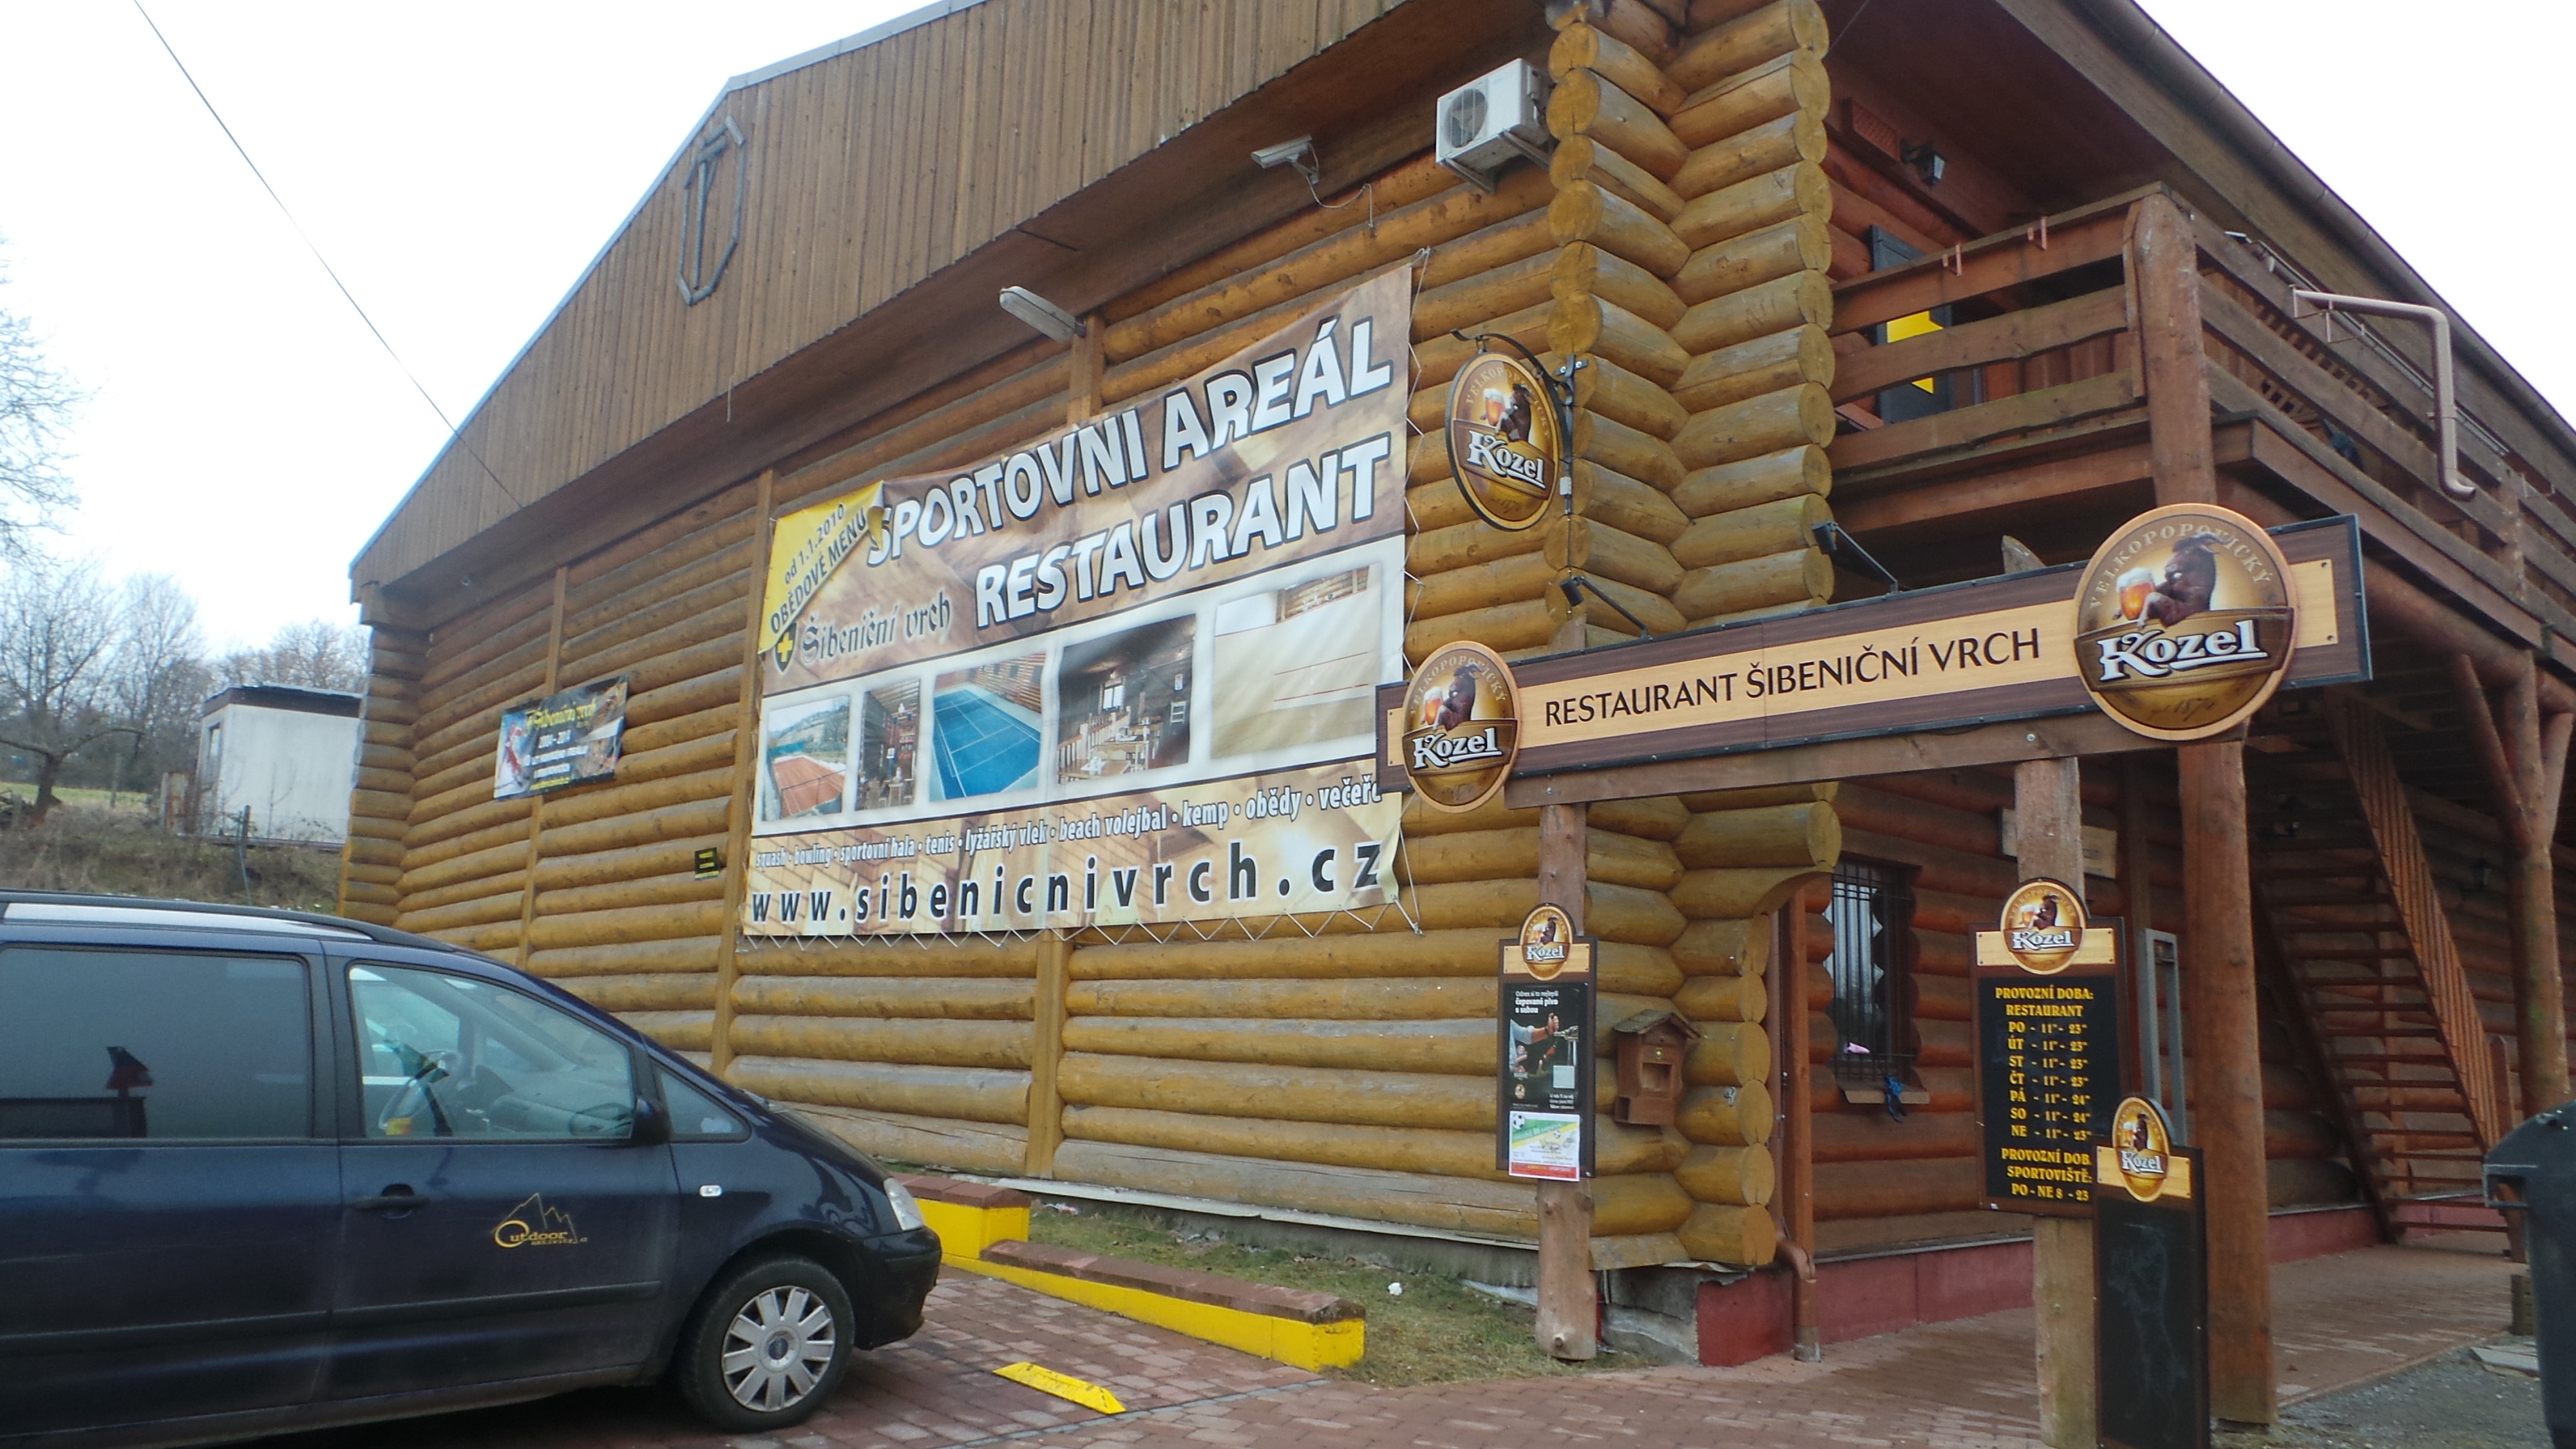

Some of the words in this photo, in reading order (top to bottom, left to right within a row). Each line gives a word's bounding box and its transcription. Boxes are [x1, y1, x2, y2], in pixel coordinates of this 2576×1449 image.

[867, 407, 1148, 567] SPORTOVNI
[1163, 314, 1393, 473] AREÁL
[1466, 430, 1546, 489] Kozel
[976, 431, 1392, 630] RESTAURANT
[784, 558, 796, 585] od
[799, 504, 844, 561] 1.1.2010
[771, 552, 827, 634] OBĚDOVÉ
[829, 506, 866, 567] MENU
[802, 605, 900, 663] Šibeniční
[905, 590, 951, 640] vrch
[2097, 619, 2269, 682] Kozel
[1546, 672, 1738, 727] RESTAURANT
[1746, 636, 1919, 699] ŠIBENIČNÍ
[1929, 627, 2040, 672] VRCH
[1413, 727, 1502, 770] Kozel
[756, 846, 786, 872] squash
[794, 843, 832, 869] bowling
[840, 837, 891, 867] sportovní
[891, 835, 915, 857] hala
[925, 830, 954, 855] tenis
[965, 822, 1018, 856] lyžařský
[1019, 819, 1048, 846] vlek
[1059, 812, 1101, 842] beach
[1104, 802, 1168, 839] volejbal
[1182, 800, 1229, 830] kemp
[1245, 785, 1302, 822] obědy
[752, 839, 1382, 924] www.sibenicnivrch.cz
[2012, 931, 2075, 951] Kozel
[1526, 945, 1565, 961] Kozel
[1995, 985, 2054, 999] PROVOZNÍ
[2057, 987, 2094, 999] DOBA:
[2005, 1004, 2084, 1016] RESTAURANT
[2008, 1021, 2026, 1033] PO
[2007, 1035, 2024, 1050] ÚT
[2009, 1055, 2024, 1067] ST
[2009, 1070, 2025, 1084] ČT
[2009, 1087, 2027, 1103] PÁ
[2010, 1107, 2027, 1119] SO
[2011, 1124, 2027, 1137] NE
[2002, 1148, 2061, 1163] PROVOZNÍ
[2063, 1152, 2092, 1166] DOB
[2121, 1150, 2164, 1173] Kozel
[2007, 1165, 2092, 1183] SPORTOVIŠTĚ:
[2011, 1183, 2028, 1196] PO
[2037, 1185, 2054, 1198] NE
[495, 1220, 567, 1247] Outdoor
